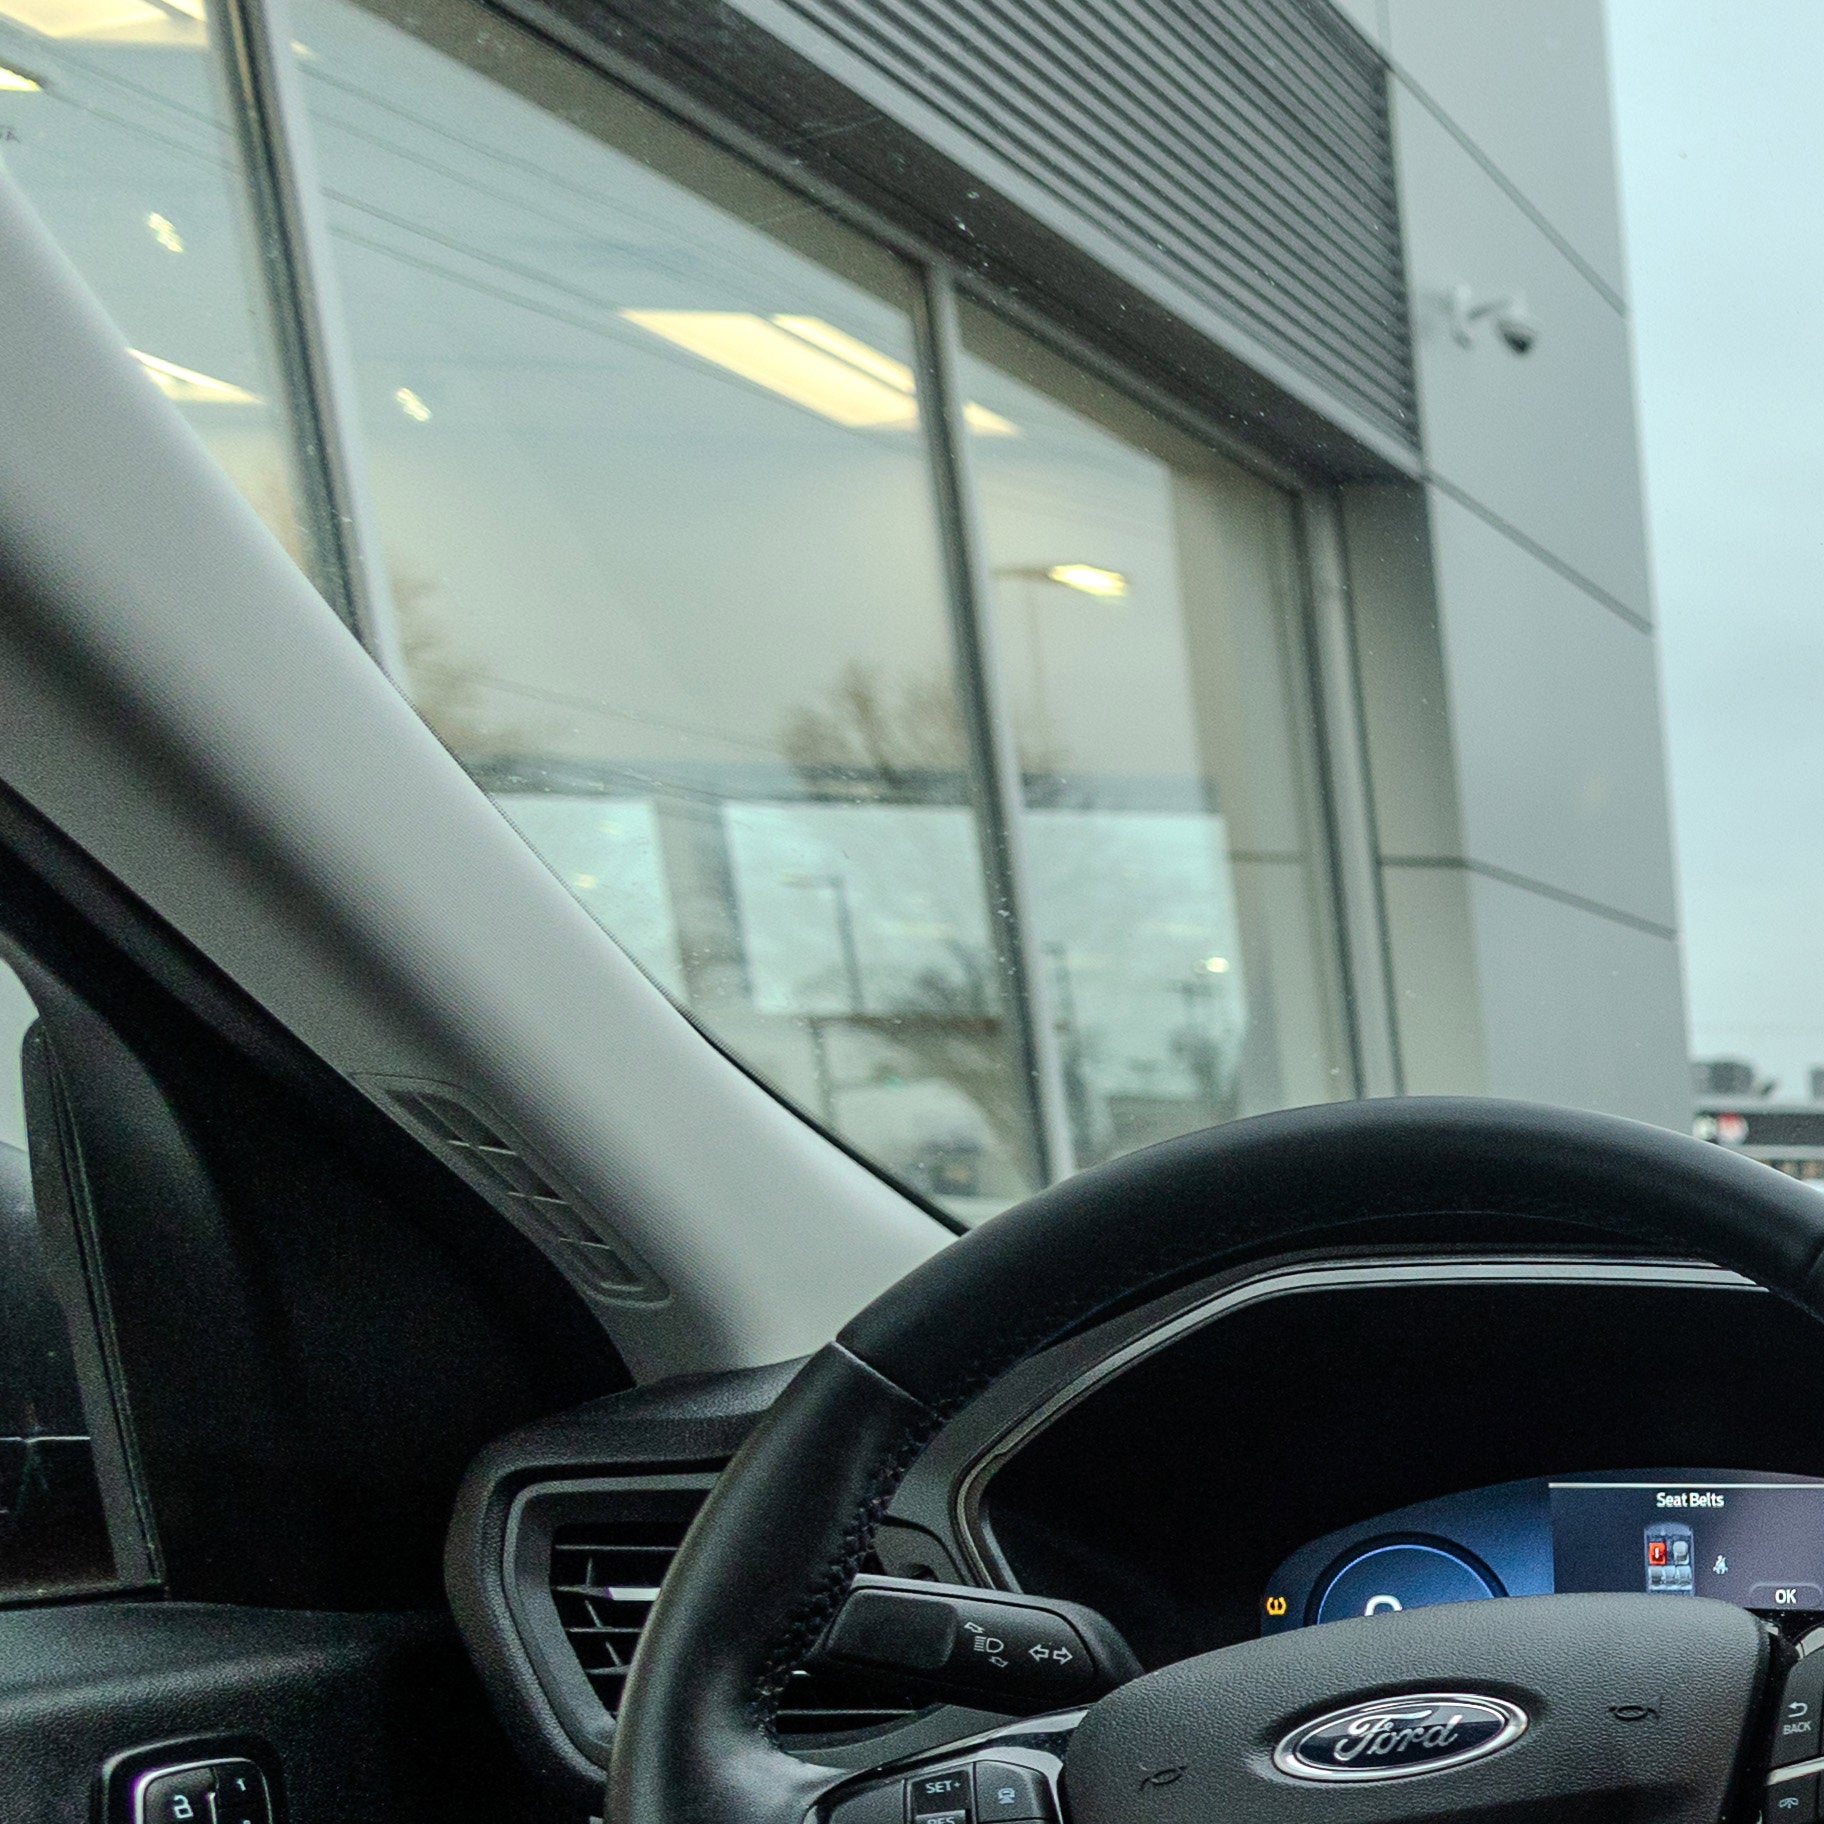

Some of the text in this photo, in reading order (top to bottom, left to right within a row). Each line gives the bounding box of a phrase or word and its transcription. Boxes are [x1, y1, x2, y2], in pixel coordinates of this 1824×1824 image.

[1656, 1492, 1725, 1508] Seat Belts
[1775, 1588, 1797, 1604] OK
[1333, 1709, 1464, 1762] Ford
[1782, 1720, 1812, 1735] BACK
